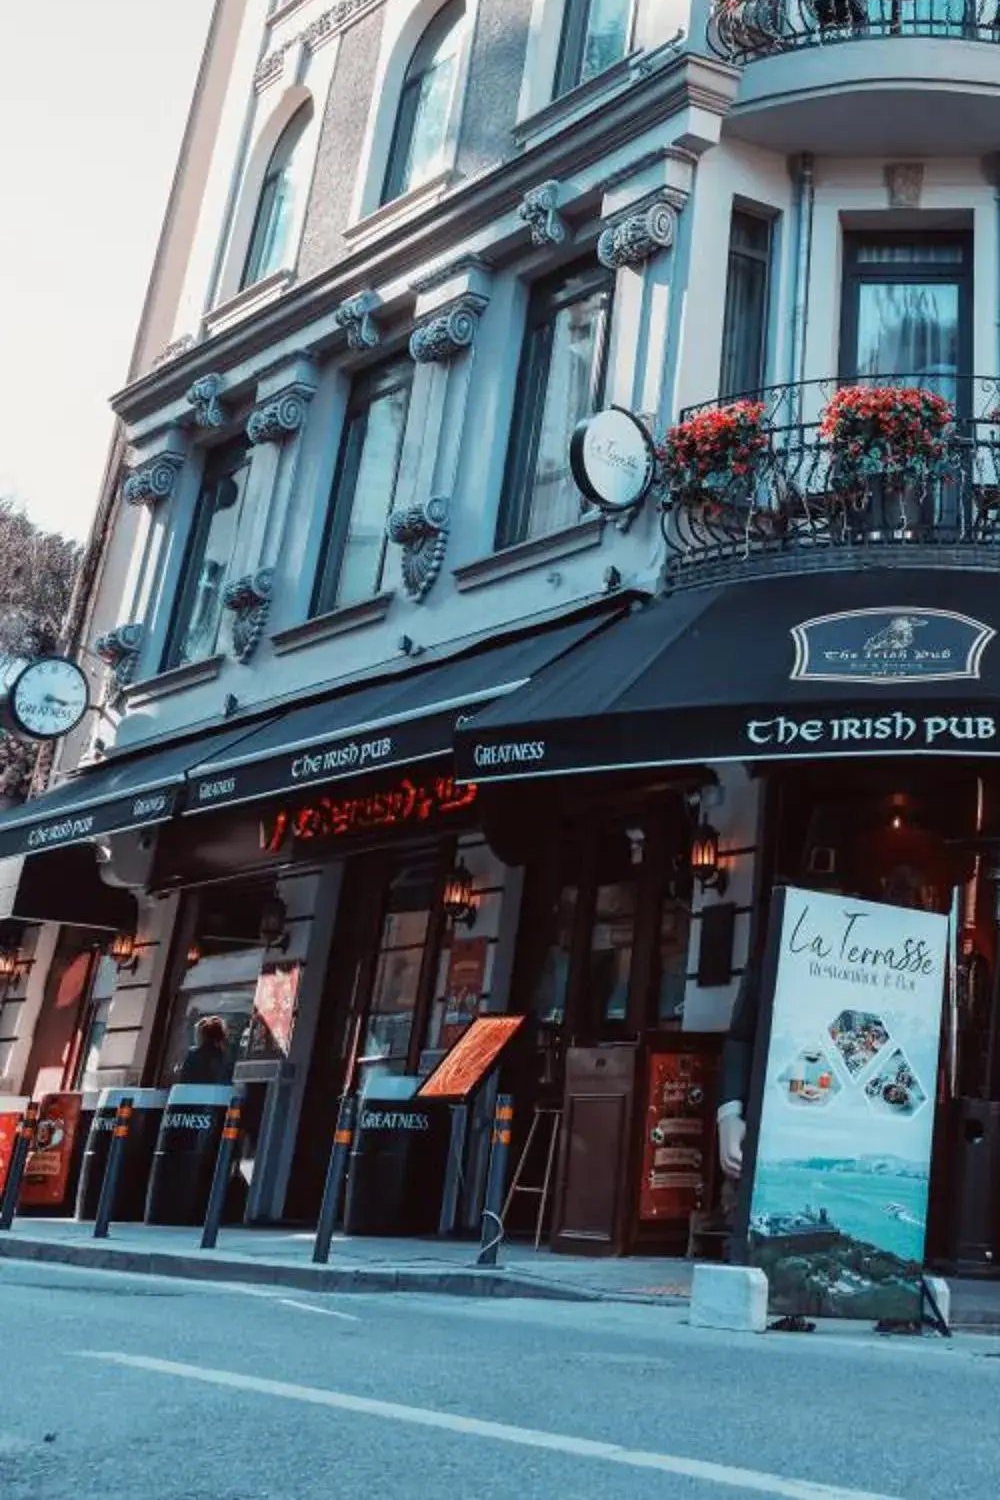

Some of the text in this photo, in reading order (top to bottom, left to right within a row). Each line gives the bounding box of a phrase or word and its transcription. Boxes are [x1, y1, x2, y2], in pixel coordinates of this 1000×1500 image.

[747, 715, 825, 746] The
[291, 755, 321, 777] The
[474, 741, 545, 766] GREATNESS
[789, 905, 936, 976] La Terrasse
[360, 1110, 429, 1131] GREATNESS
